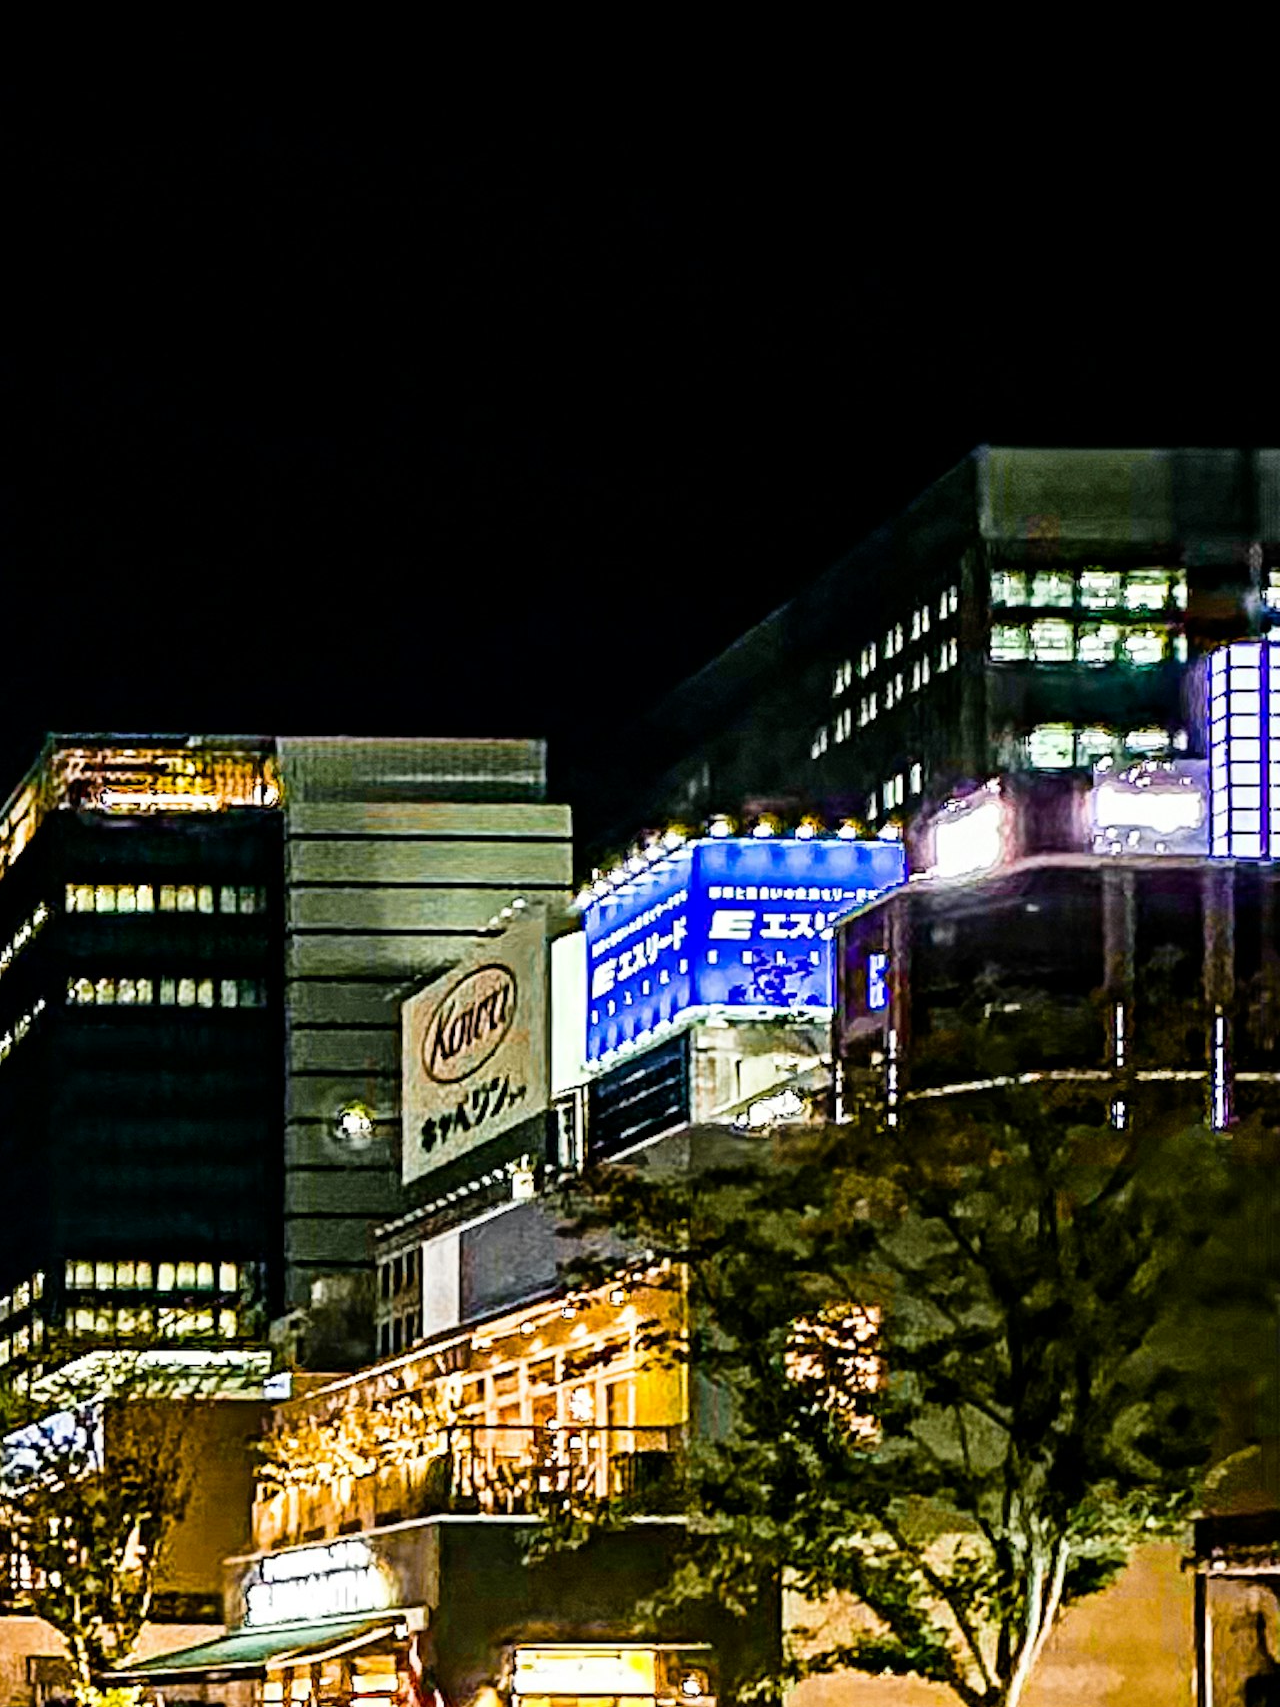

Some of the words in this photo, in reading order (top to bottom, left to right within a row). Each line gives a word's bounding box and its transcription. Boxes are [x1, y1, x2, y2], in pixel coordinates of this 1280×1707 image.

[616, 915, 689, 982] エスリード
[429, 983, 511, 1072] Kowa
